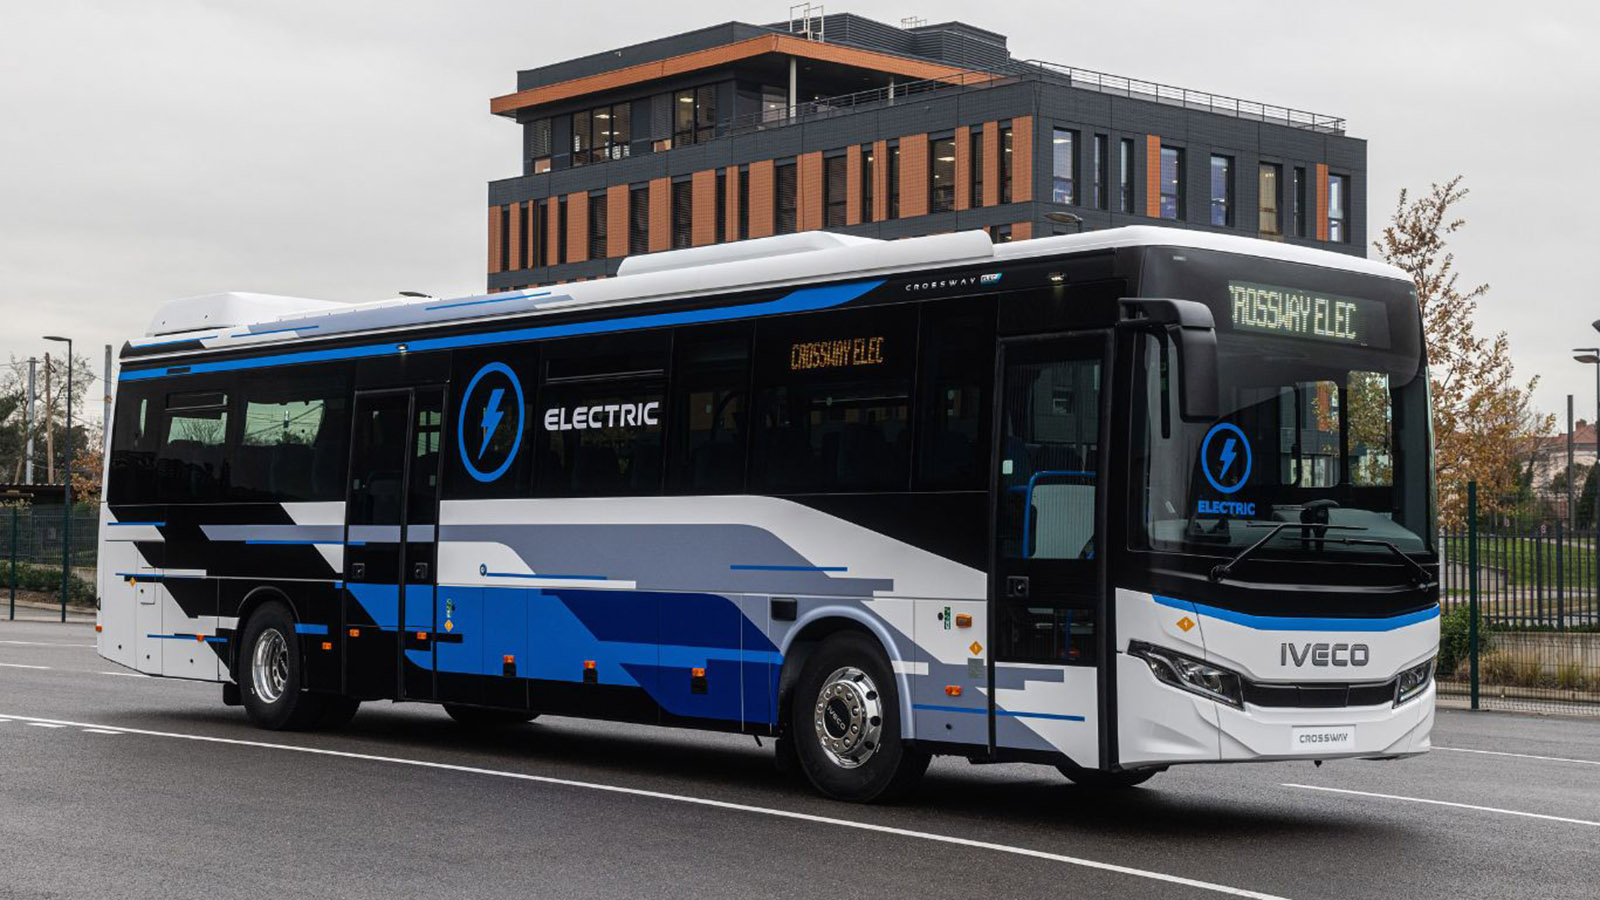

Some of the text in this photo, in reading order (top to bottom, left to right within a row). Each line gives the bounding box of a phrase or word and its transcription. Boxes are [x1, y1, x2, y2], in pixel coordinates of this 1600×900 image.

[905, 278, 976, 291] CROSSWAY
[1313, 298, 1357, 339] ELEC
[791, 337, 885, 370] CROSSWAY ELEC
[544, 402, 660, 431] ELECTRIC
[1197, 500, 1256, 515] ELECTRIC
[1281, 643, 1369, 667] IVECO
[827, 705, 846, 730] IVECO
[1299, 733, 1349, 744] CROSSWAY
